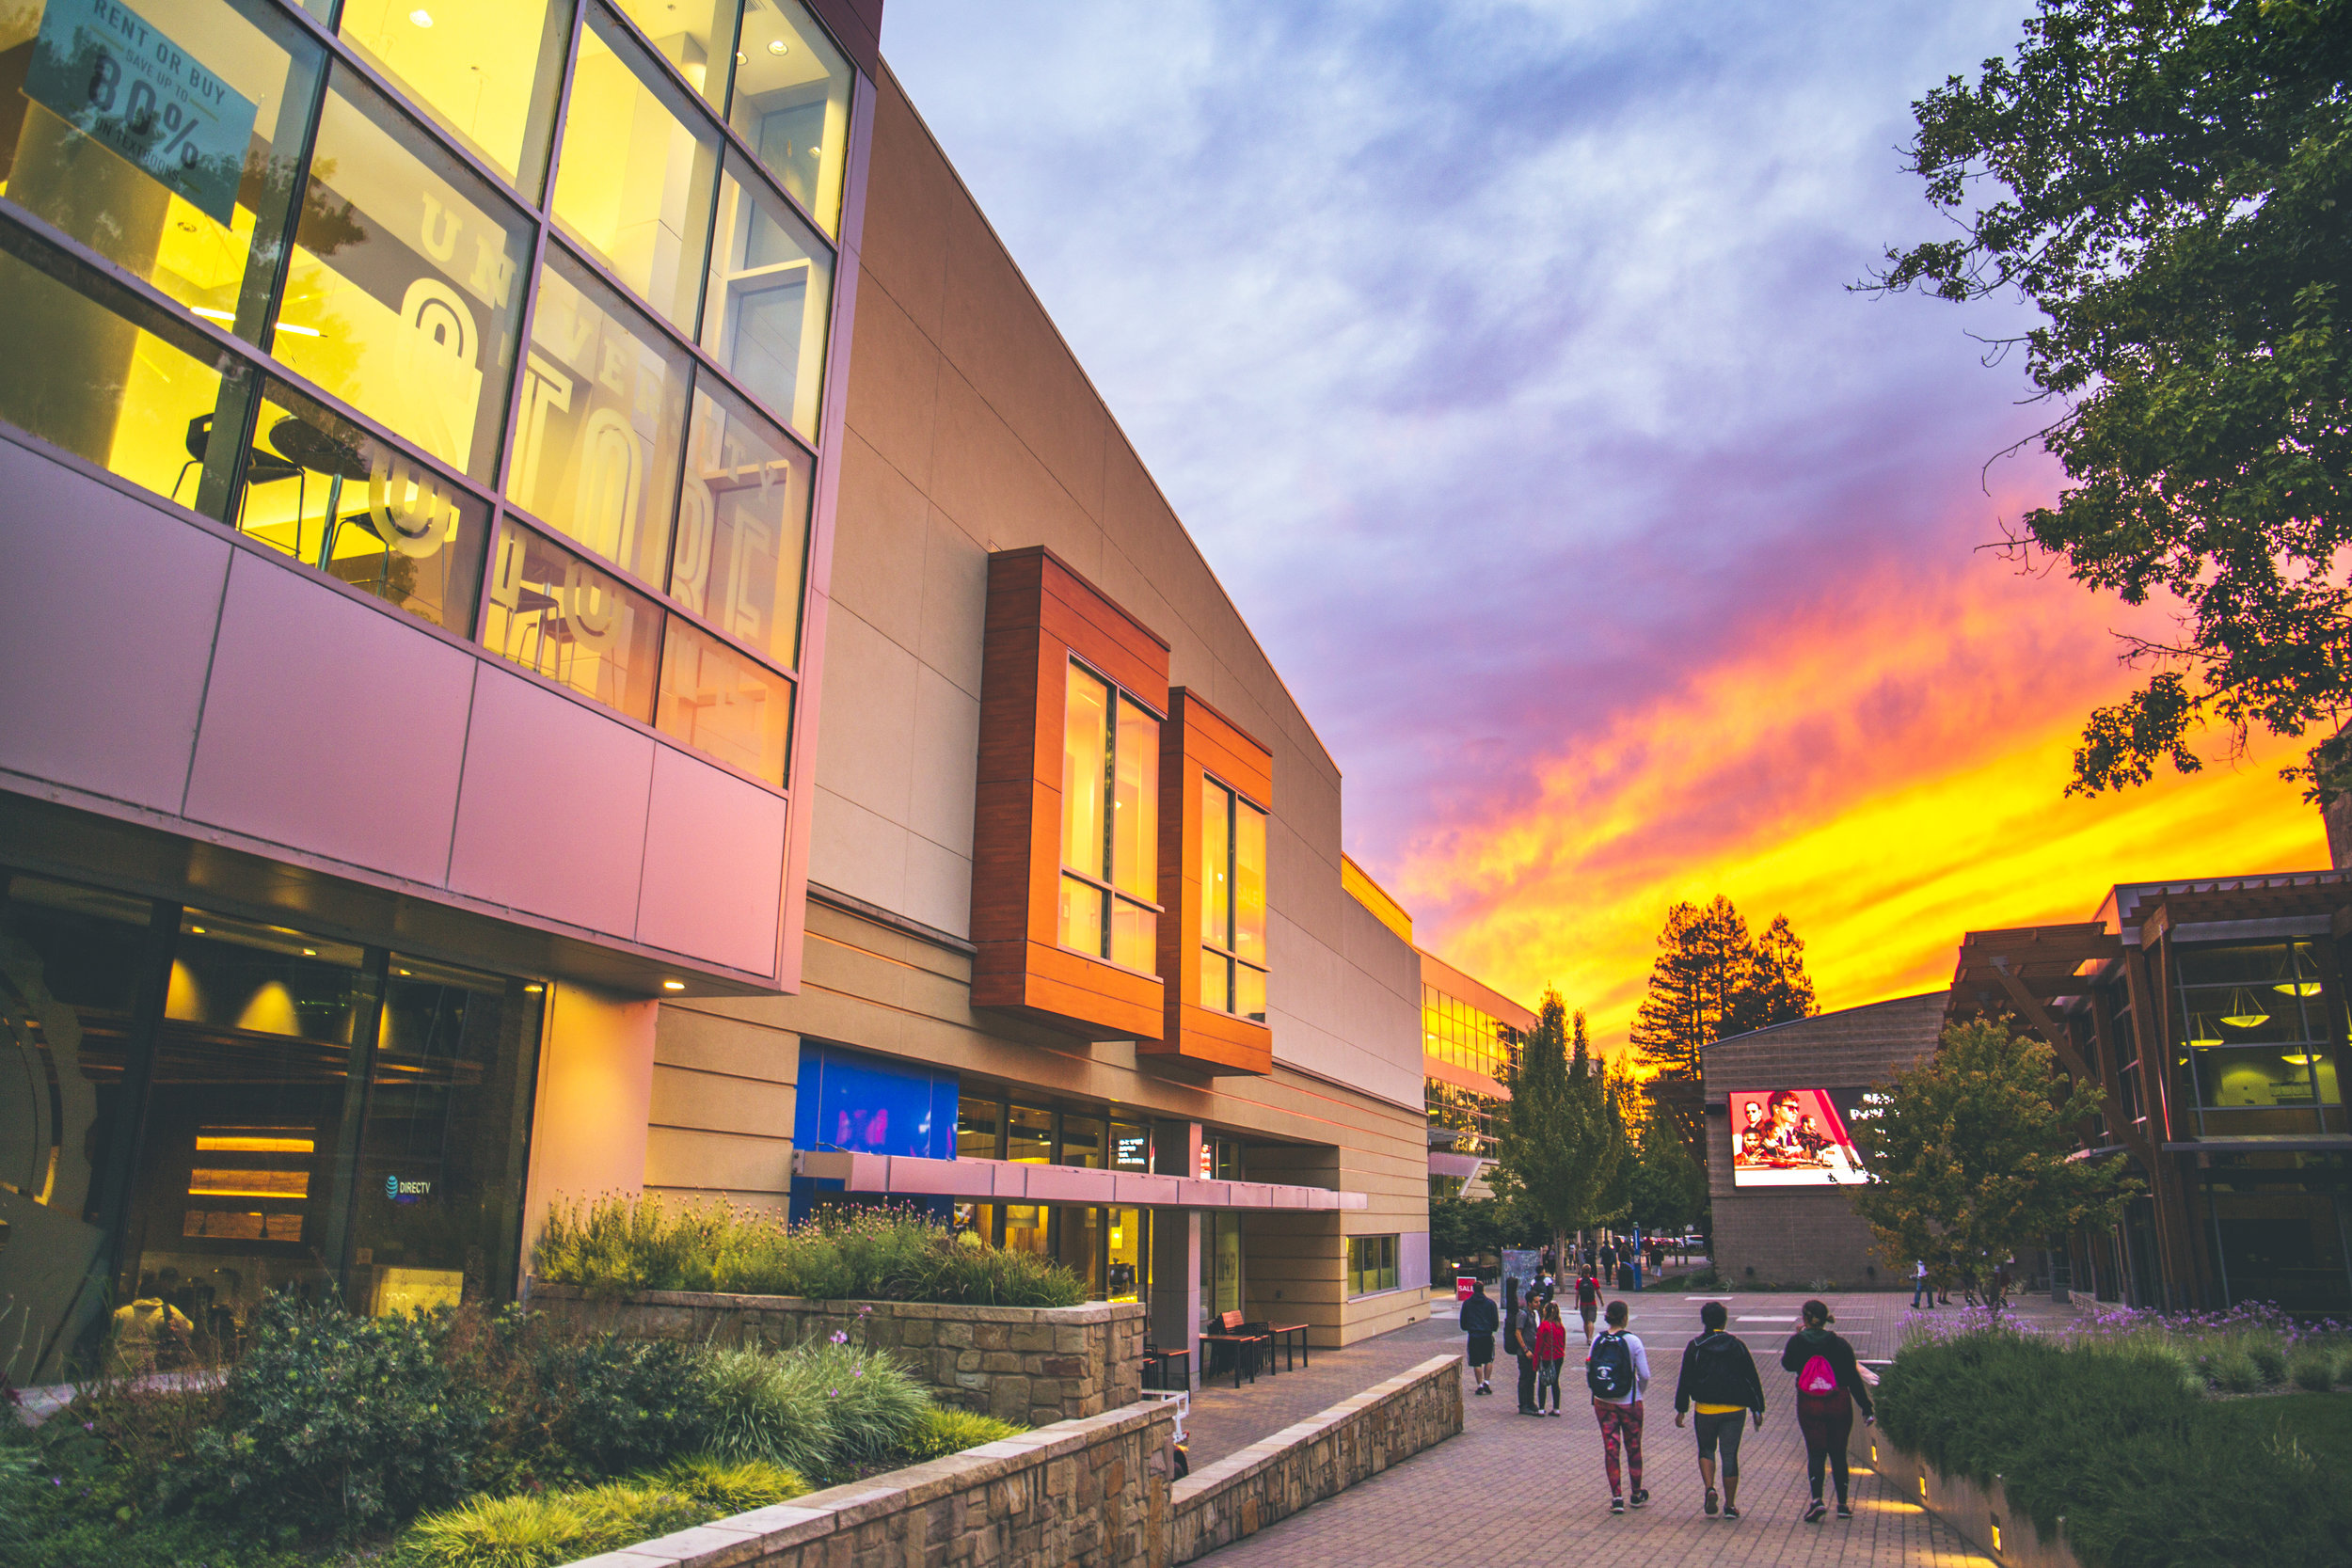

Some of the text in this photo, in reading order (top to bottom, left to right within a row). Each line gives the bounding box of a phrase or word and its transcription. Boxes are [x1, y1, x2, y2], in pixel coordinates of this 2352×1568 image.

[94, 0, 225, 104] RENT OR BUY
[125, 49, 188, 103] SAVE UP TO
[88, 54, 199, 169] 80%
[95, 117, 180, 182] ON TEXTBOOKS
[368, 277, 773, 726] STORE
[399, 1181, 431, 1194] DIRECTV
